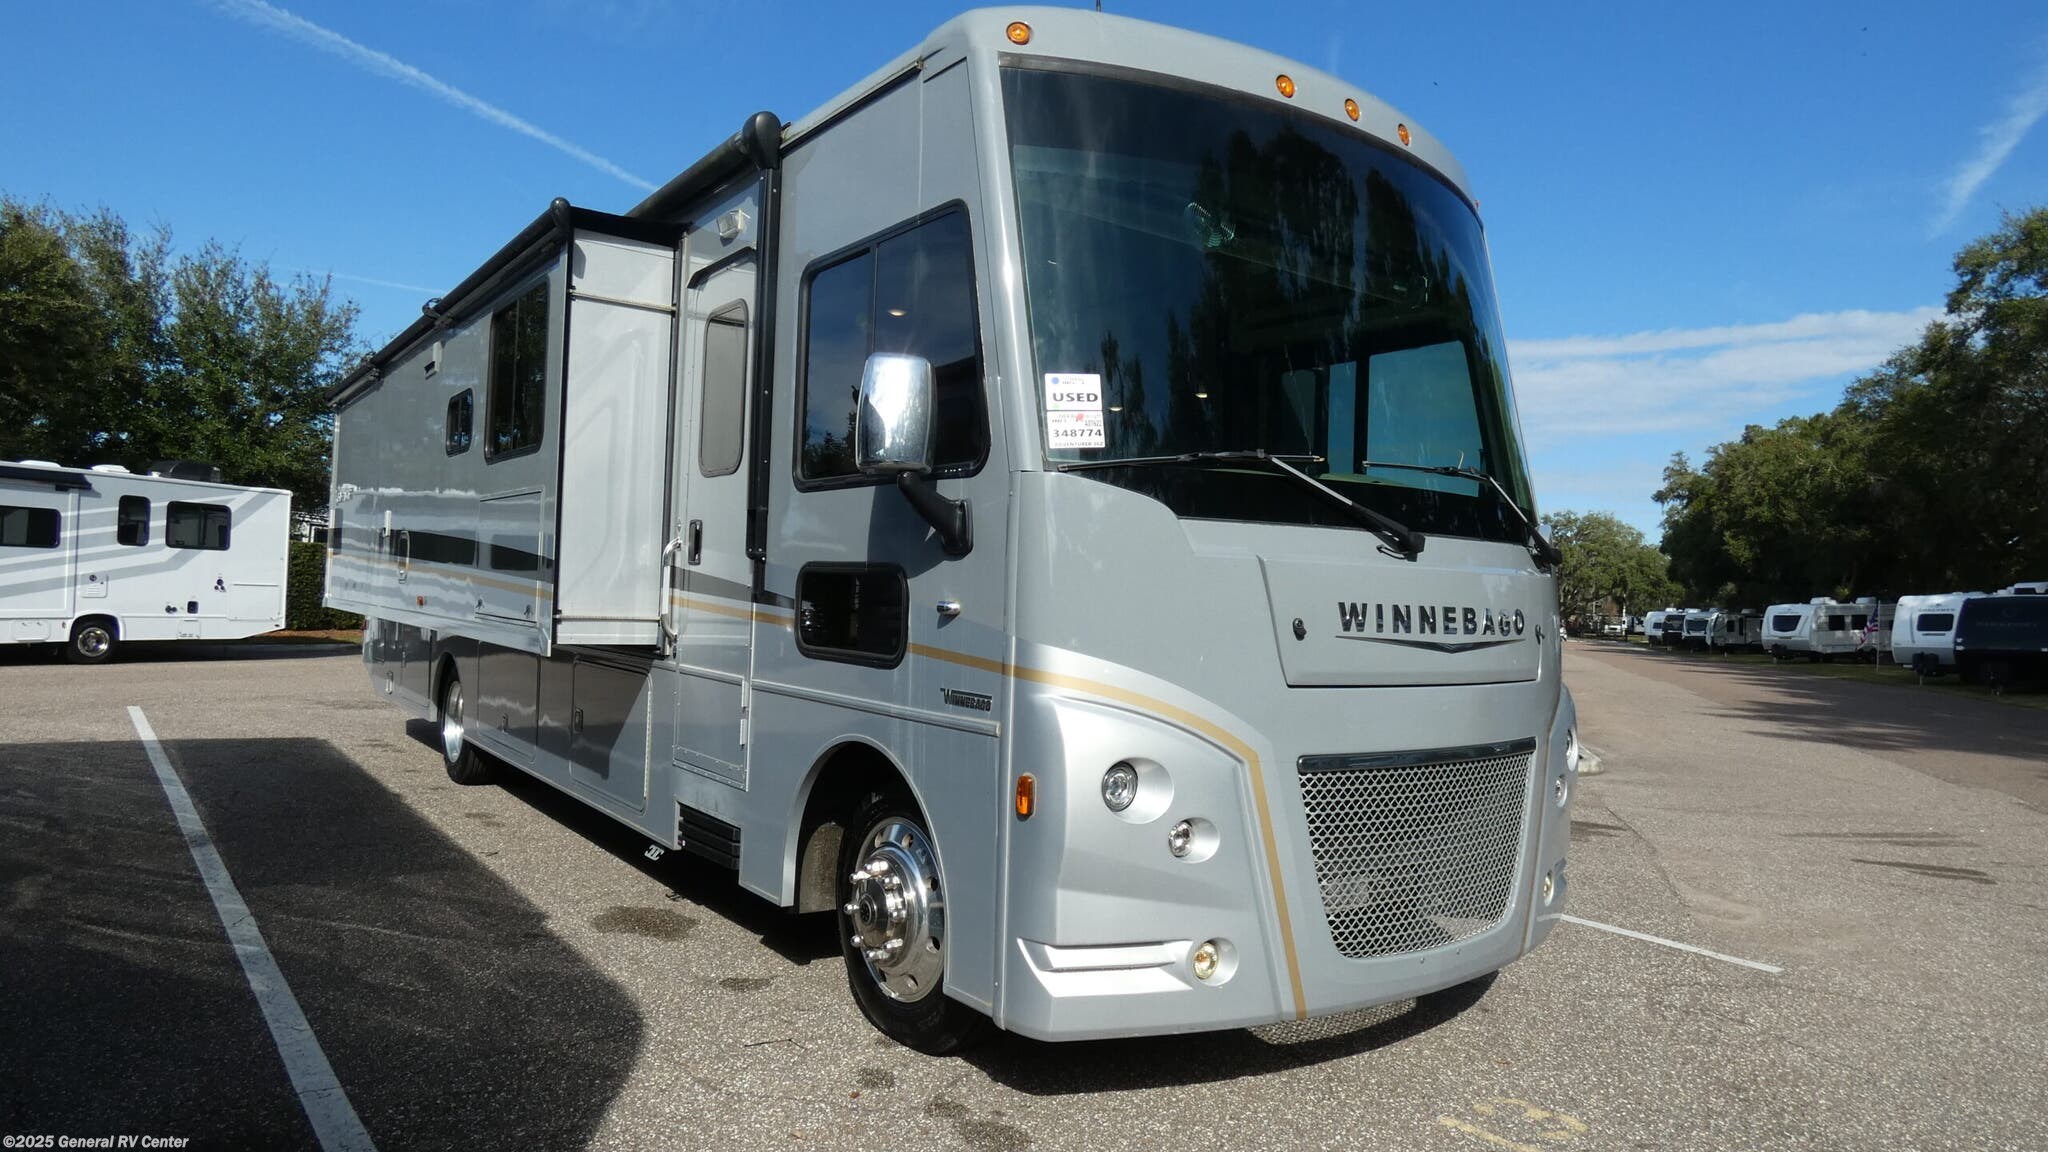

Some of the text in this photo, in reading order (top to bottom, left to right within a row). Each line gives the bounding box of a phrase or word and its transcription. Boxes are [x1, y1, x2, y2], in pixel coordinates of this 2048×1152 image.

[1052, 392, 1099, 403] USED
[1053, 428, 1103, 438] 348774
[1338, 602, 1525, 637] WINNEBAGO
[941, 688, 992, 712] WINNEBAGO
